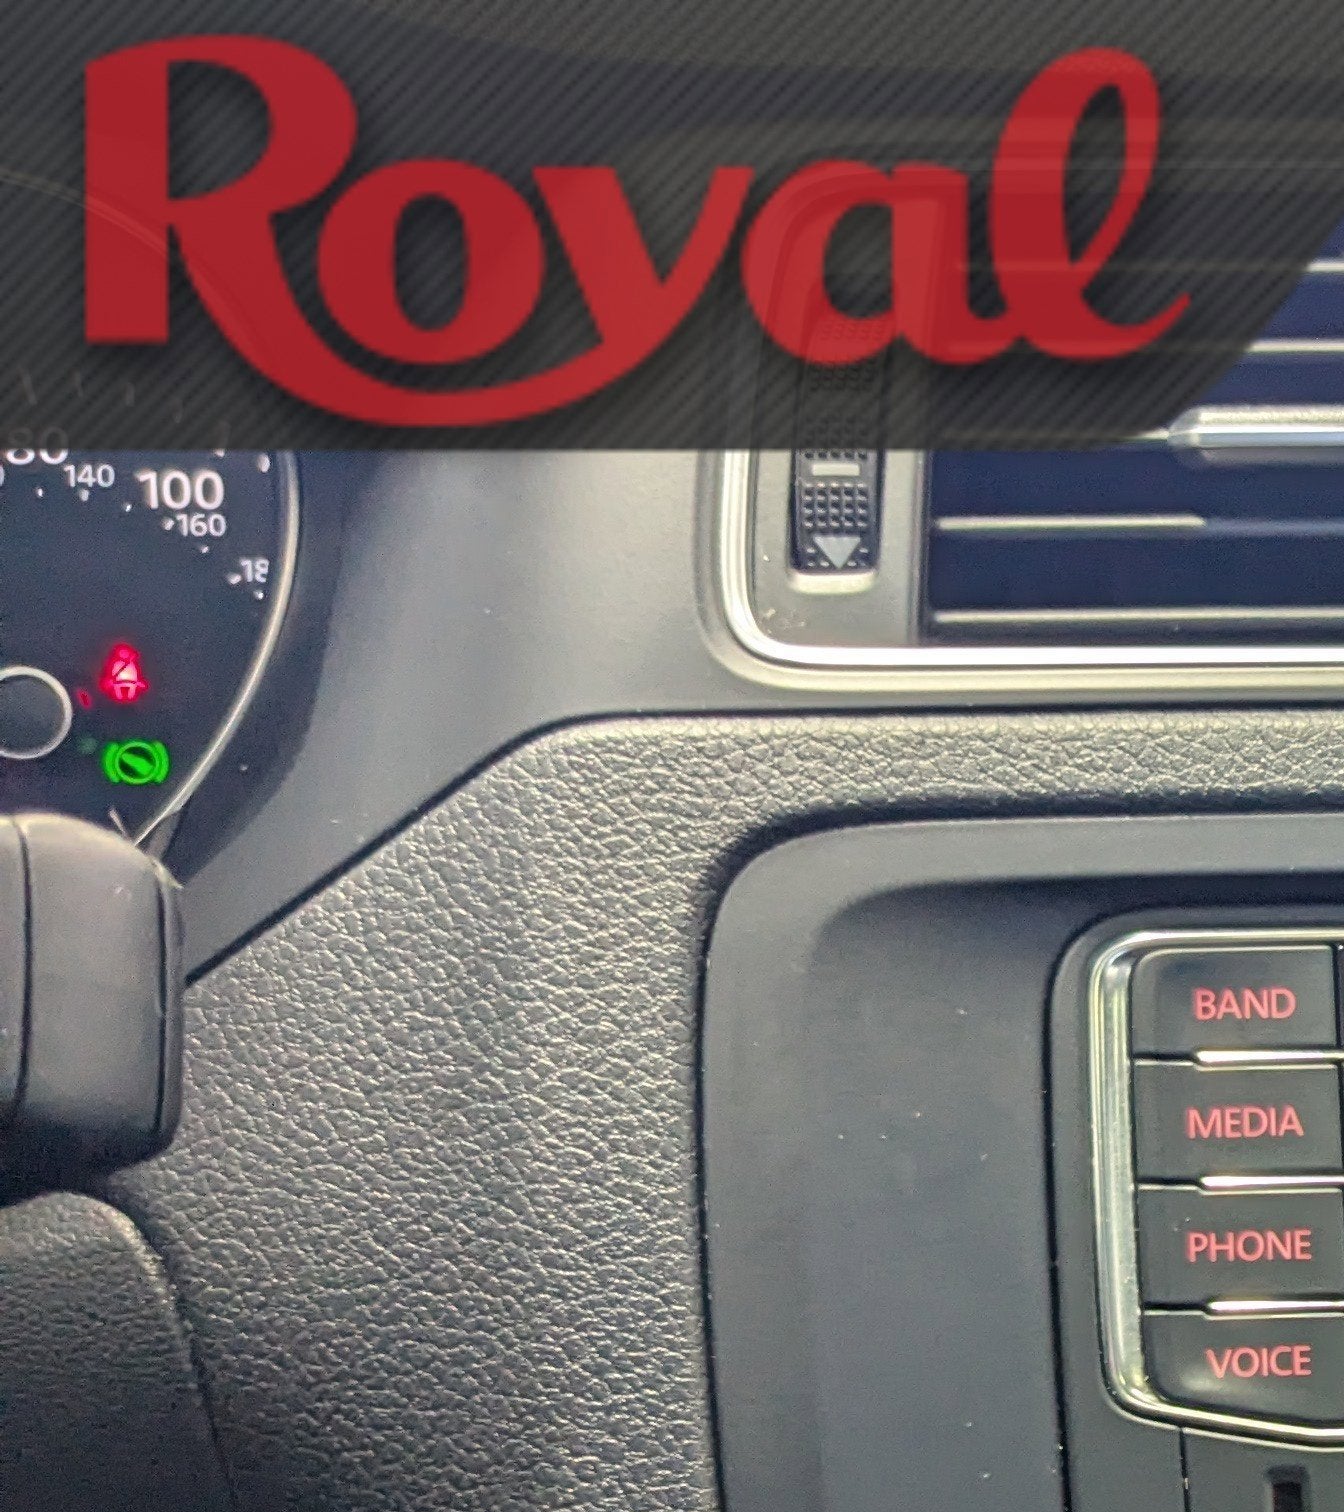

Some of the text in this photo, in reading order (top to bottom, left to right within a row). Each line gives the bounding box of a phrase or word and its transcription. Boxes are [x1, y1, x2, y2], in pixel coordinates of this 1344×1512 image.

[62, 463, 116, 489] 140
[135, 469, 226, 510] 100
[175, 512, 228, 538] 160
[1193, 986, 1297, 1022] BAND
[1185, 1104, 1304, 1140] MEDIA
[1186, 1227, 1312, 1263] PHONE
[1205, 1343, 1311, 1380] VOICE
